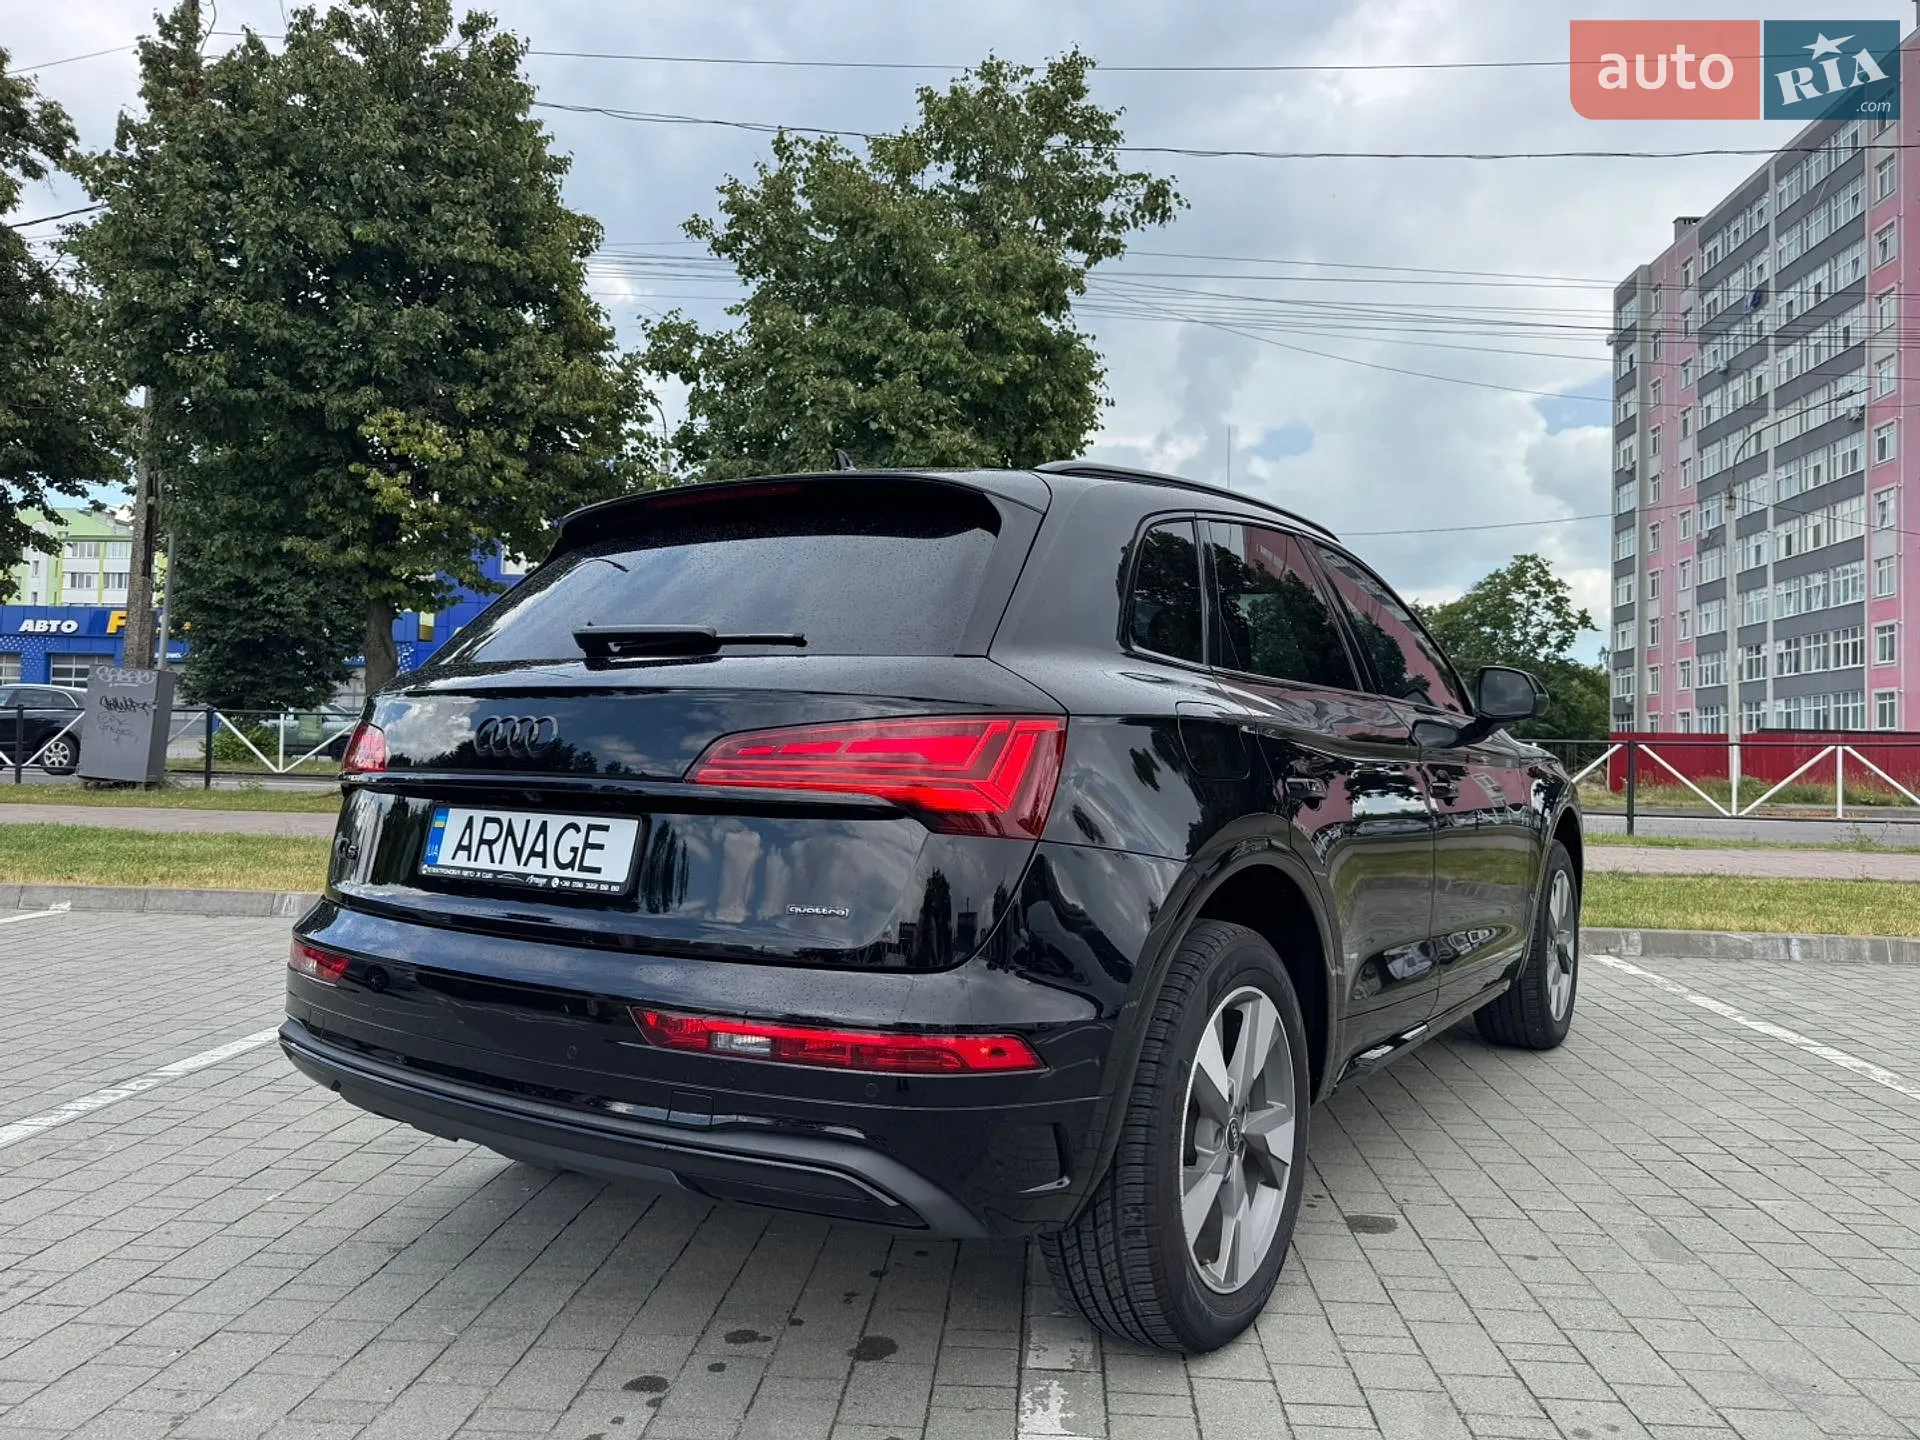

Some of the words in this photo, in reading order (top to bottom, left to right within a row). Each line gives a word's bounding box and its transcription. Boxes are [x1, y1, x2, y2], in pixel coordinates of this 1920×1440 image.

[19, 619, 79, 634] АВТО
[451, 815, 611, 874] ARNAGE
[788, 905, 847, 917] quattro
